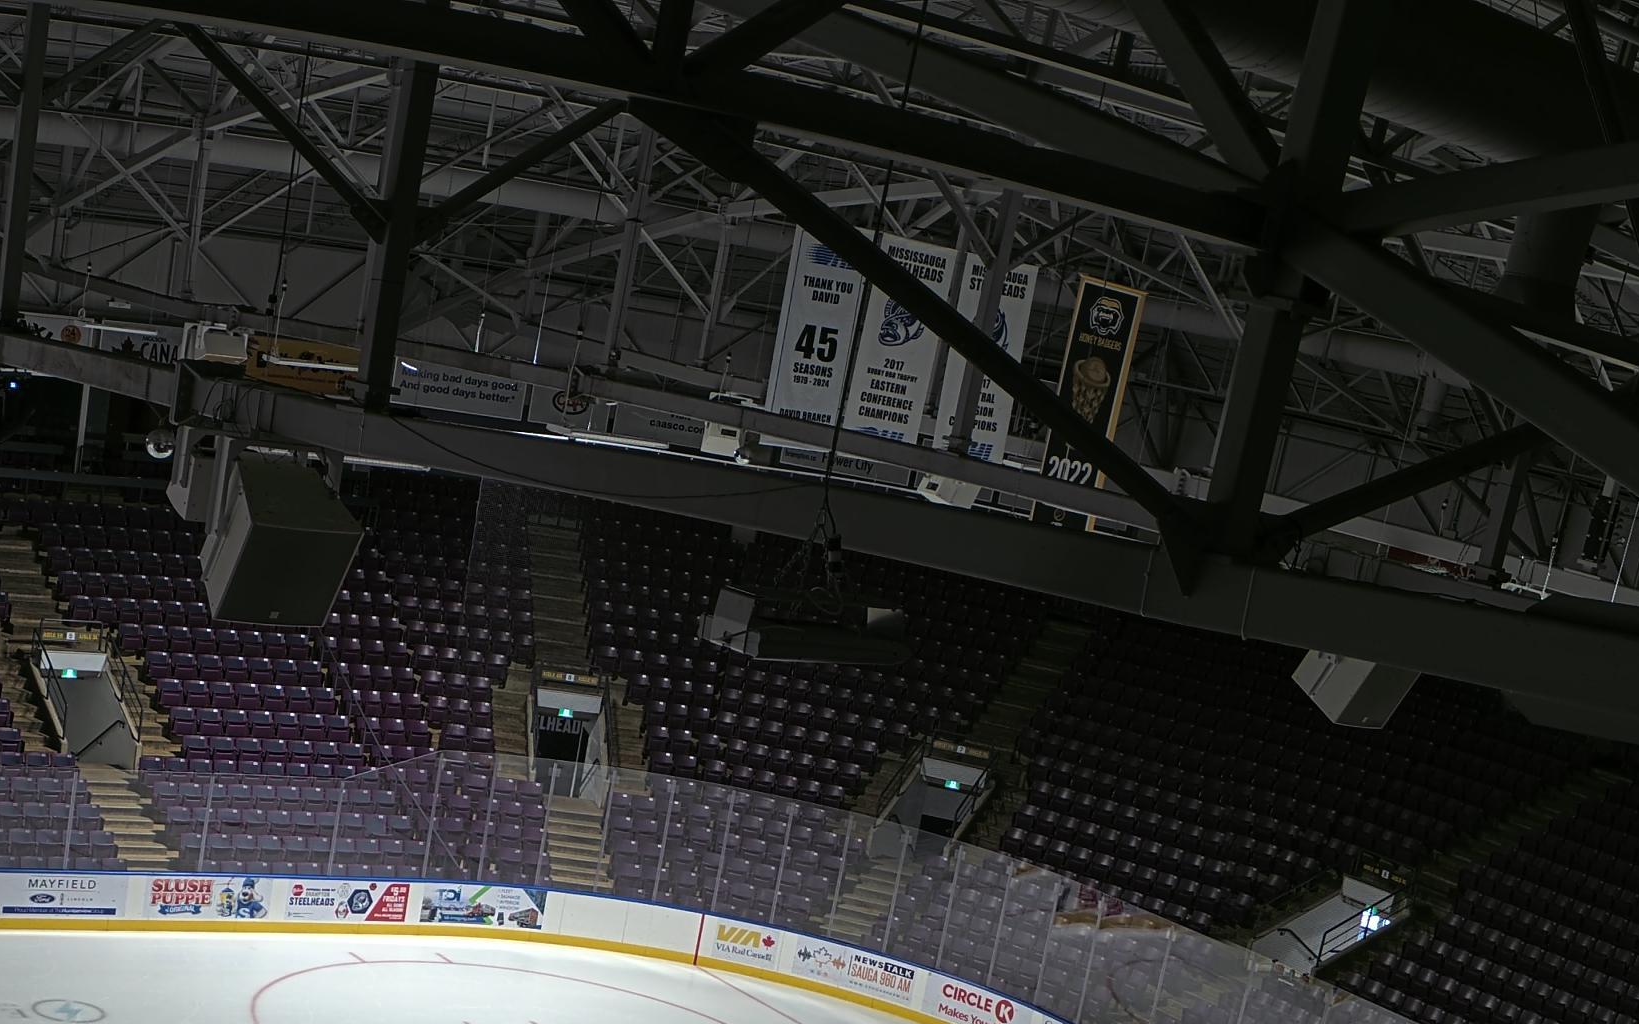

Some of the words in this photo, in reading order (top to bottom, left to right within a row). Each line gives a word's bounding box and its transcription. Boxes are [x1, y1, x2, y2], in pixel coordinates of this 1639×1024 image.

[887, 245, 946, 269] MISSISSAUGA
[803, 275, 831, 290] THANK
[833, 280, 853, 294] YOU
[812, 290, 840, 305] DAVID
[795, 324, 839, 363] 45
[792, 362, 833, 378] SEASONS
[884, 358, 904, 371] 2017
[399, 379, 420, 390] And
[423, 383, 449, 396] good
[452, 386, 477, 400] days
[442, 373, 463, 384] bad
[465, 375, 488, 389] days
[870, 381, 906, 395] EASTERN
[861, 392, 913, 411] CONFERENCE
[779, 408, 800, 420] DAVID
[858, 405, 909, 424] CHAMPIONS
[854, 460, 873, 474] City
[28, 879, 96, 889] MAYFIELD
[151, 879, 213, 893] SLUSH
[289, 897, 335, 906] STEELHEADS
[716, 924, 761, 948] VIA
[854, 954, 885, 969] NEWS
[885, 963, 914, 980] TALK
[850, 963, 880, 986] SAUGA
[880, 972, 896, 989] 960
[896, 977, 911, 993] AM
[942, 983, 993, 1013] CIRCLE
[998, 1001, 1013, 1023] K
[939, 1003, 971, 1024] Makes
